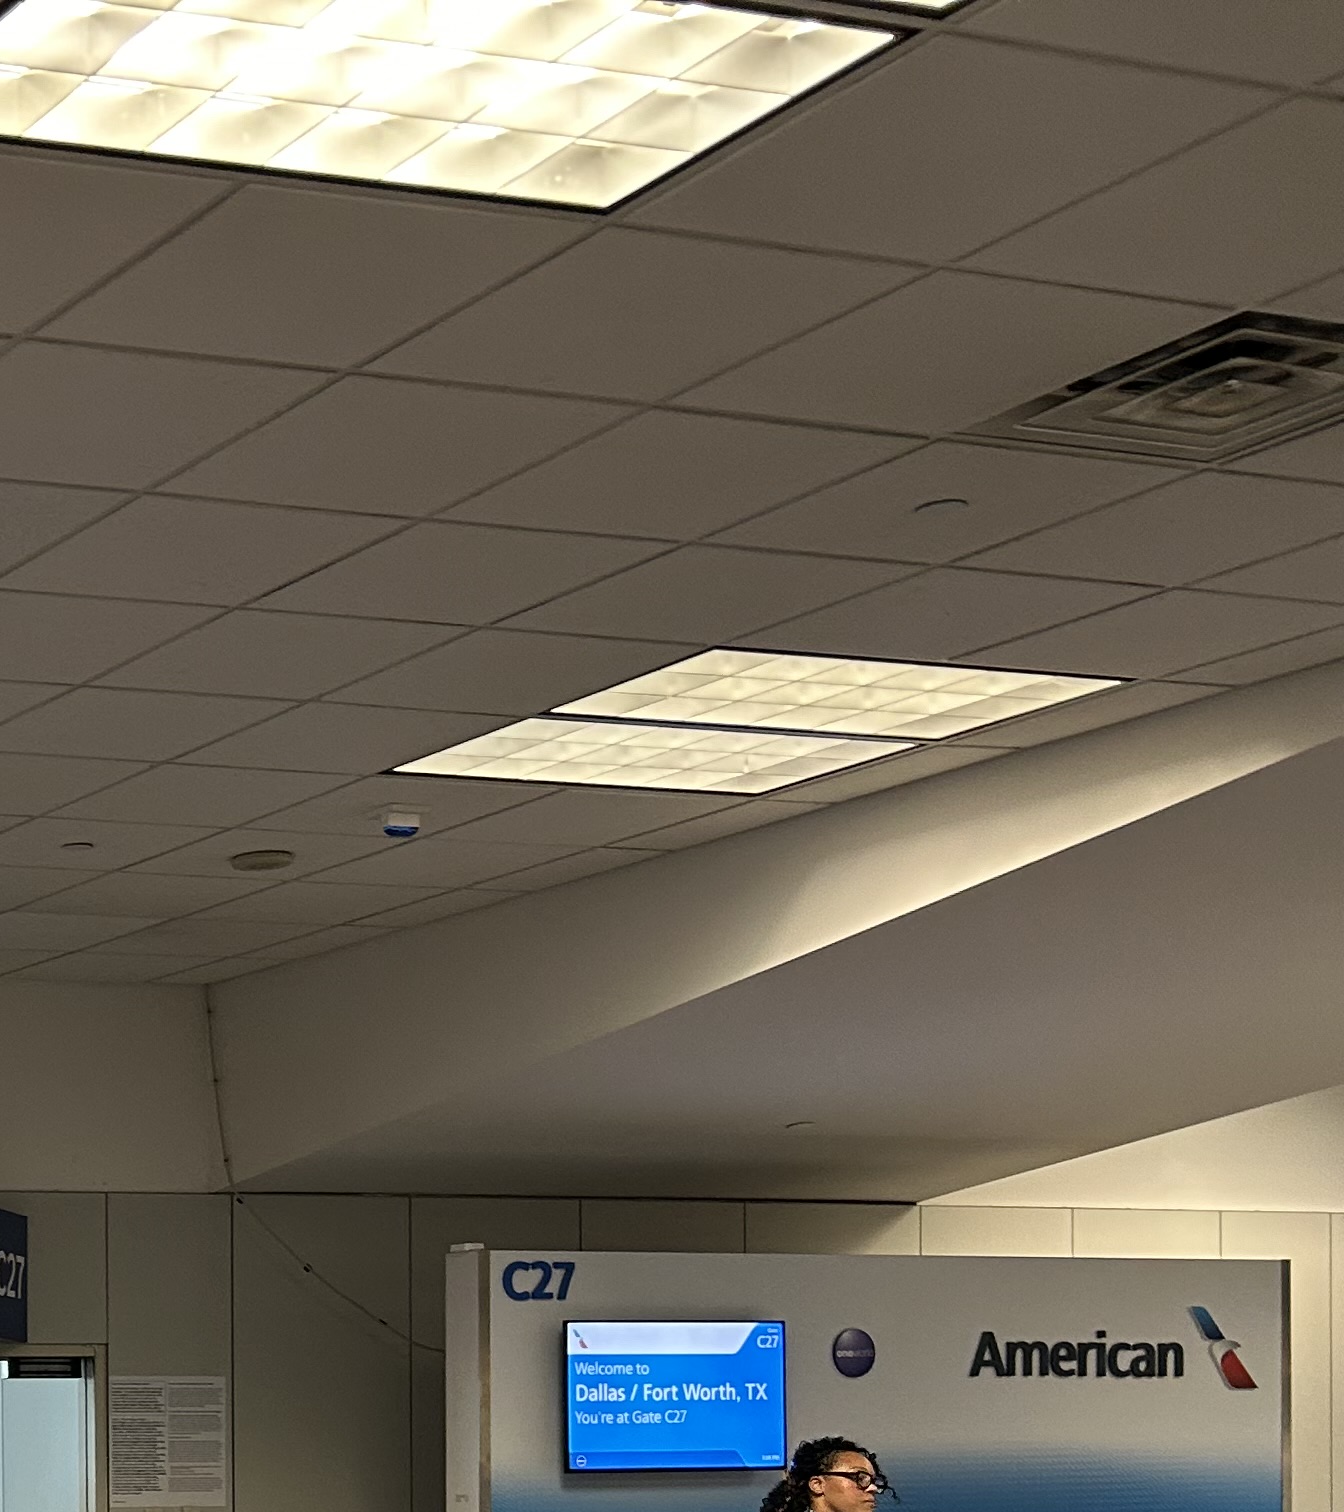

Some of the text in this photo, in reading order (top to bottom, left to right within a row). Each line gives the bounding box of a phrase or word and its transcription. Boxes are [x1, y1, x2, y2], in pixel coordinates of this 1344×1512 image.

[502, 1261, 575, 1301] C27
[757, 1335, 779, 1349] C27
[968, 1330, 1184, 1377] American
[574, 1361, 650, 1375] Welcome to
[575, 1382, 768, 1403] Dallas / Fort Worth, TX
[575, 1409, 688, 1424] You're at Gate C27
